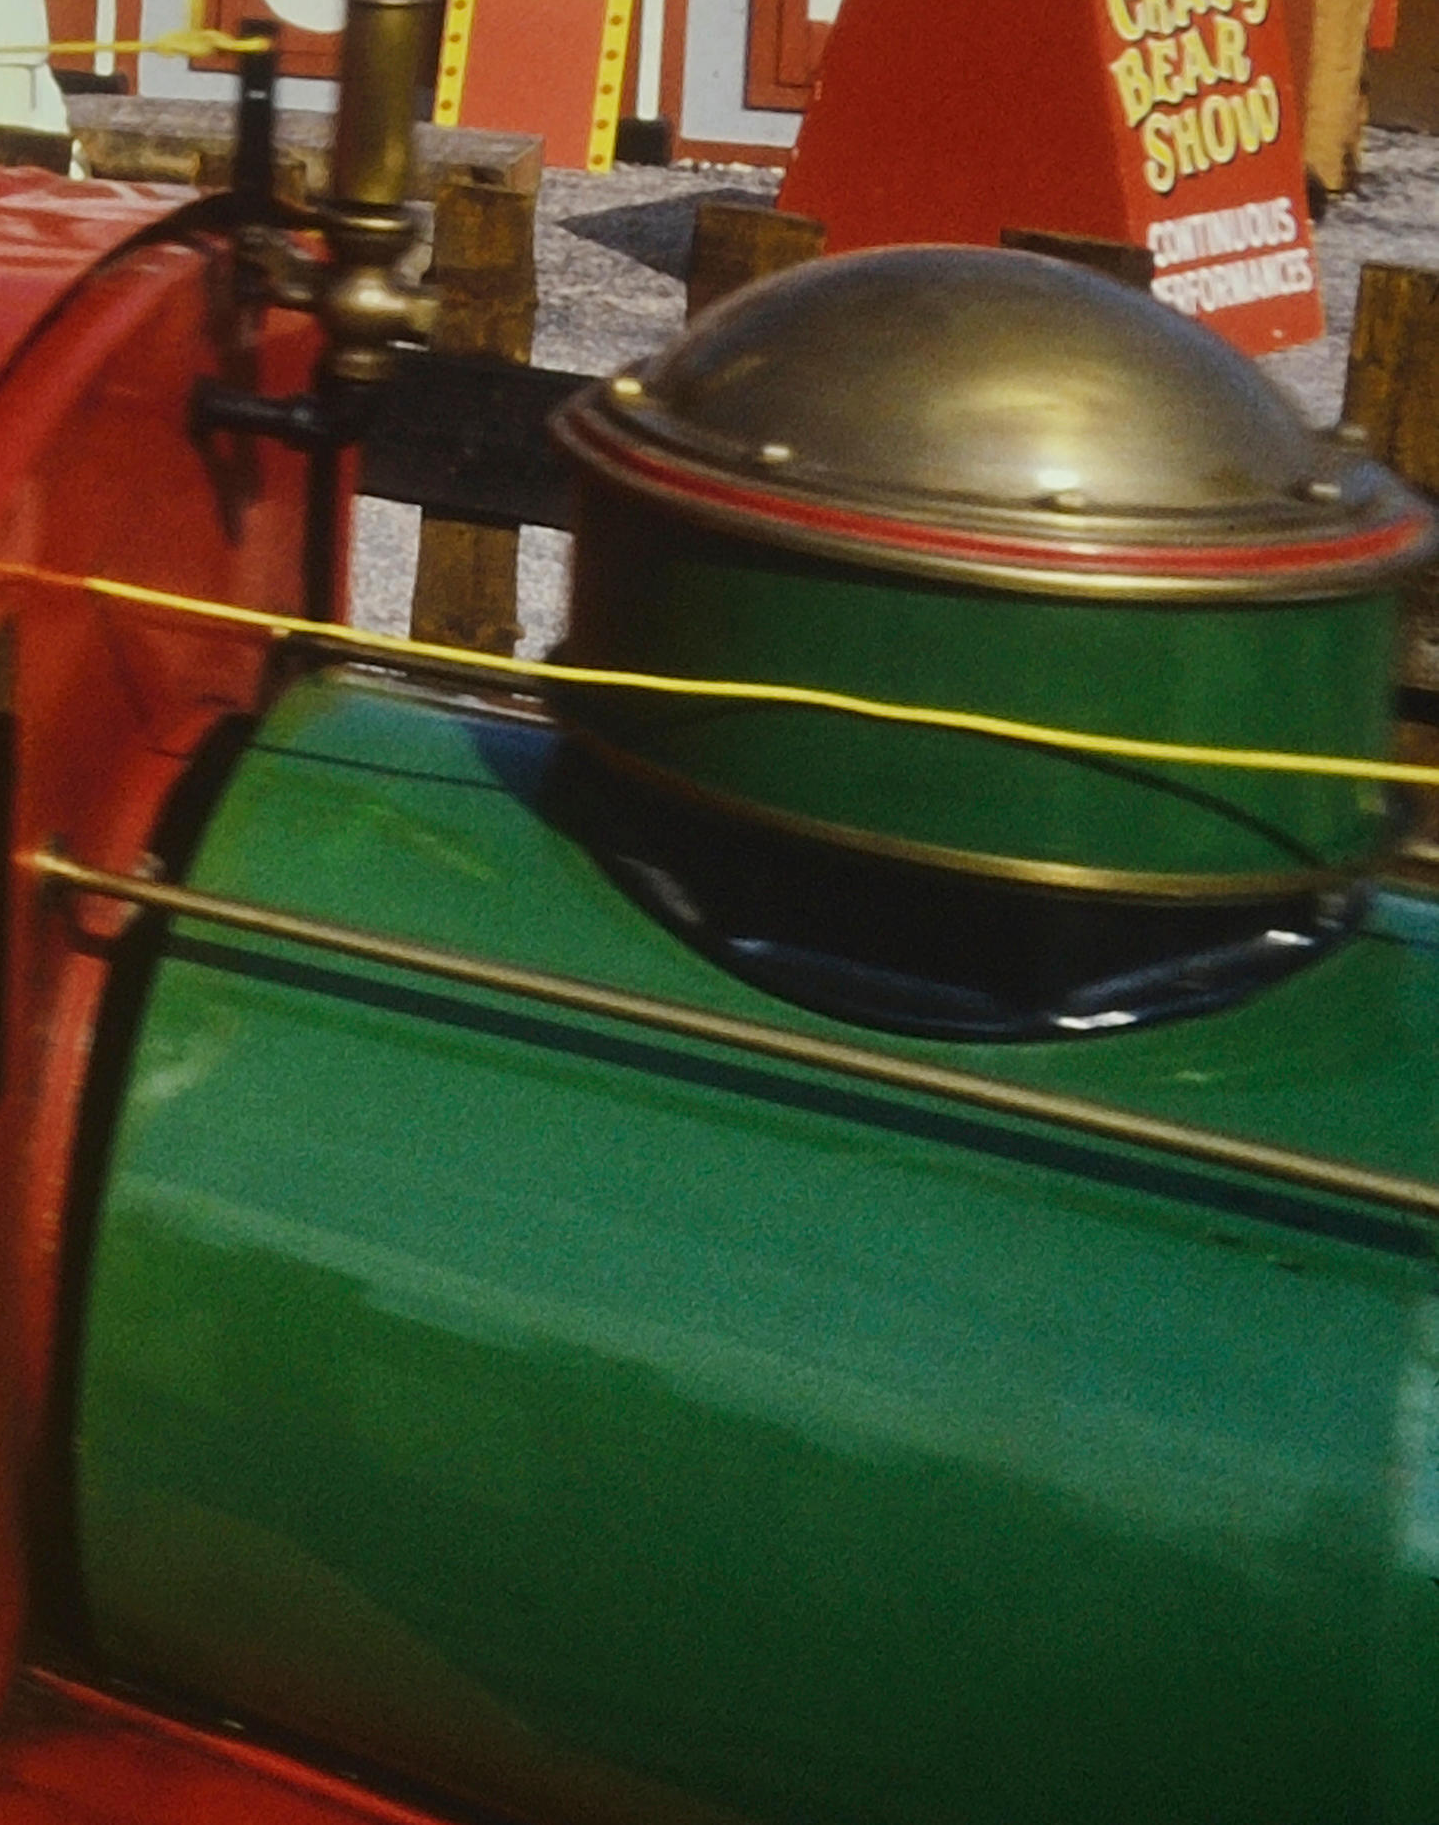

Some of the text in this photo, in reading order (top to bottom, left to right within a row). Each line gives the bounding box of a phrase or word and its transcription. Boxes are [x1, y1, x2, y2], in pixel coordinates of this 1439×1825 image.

[1109, 14, 1251, 128] BEAR
[1142, 74, 1280, 194] SHOW
[1146, 196, 1297, 268] CONTINUOUS
